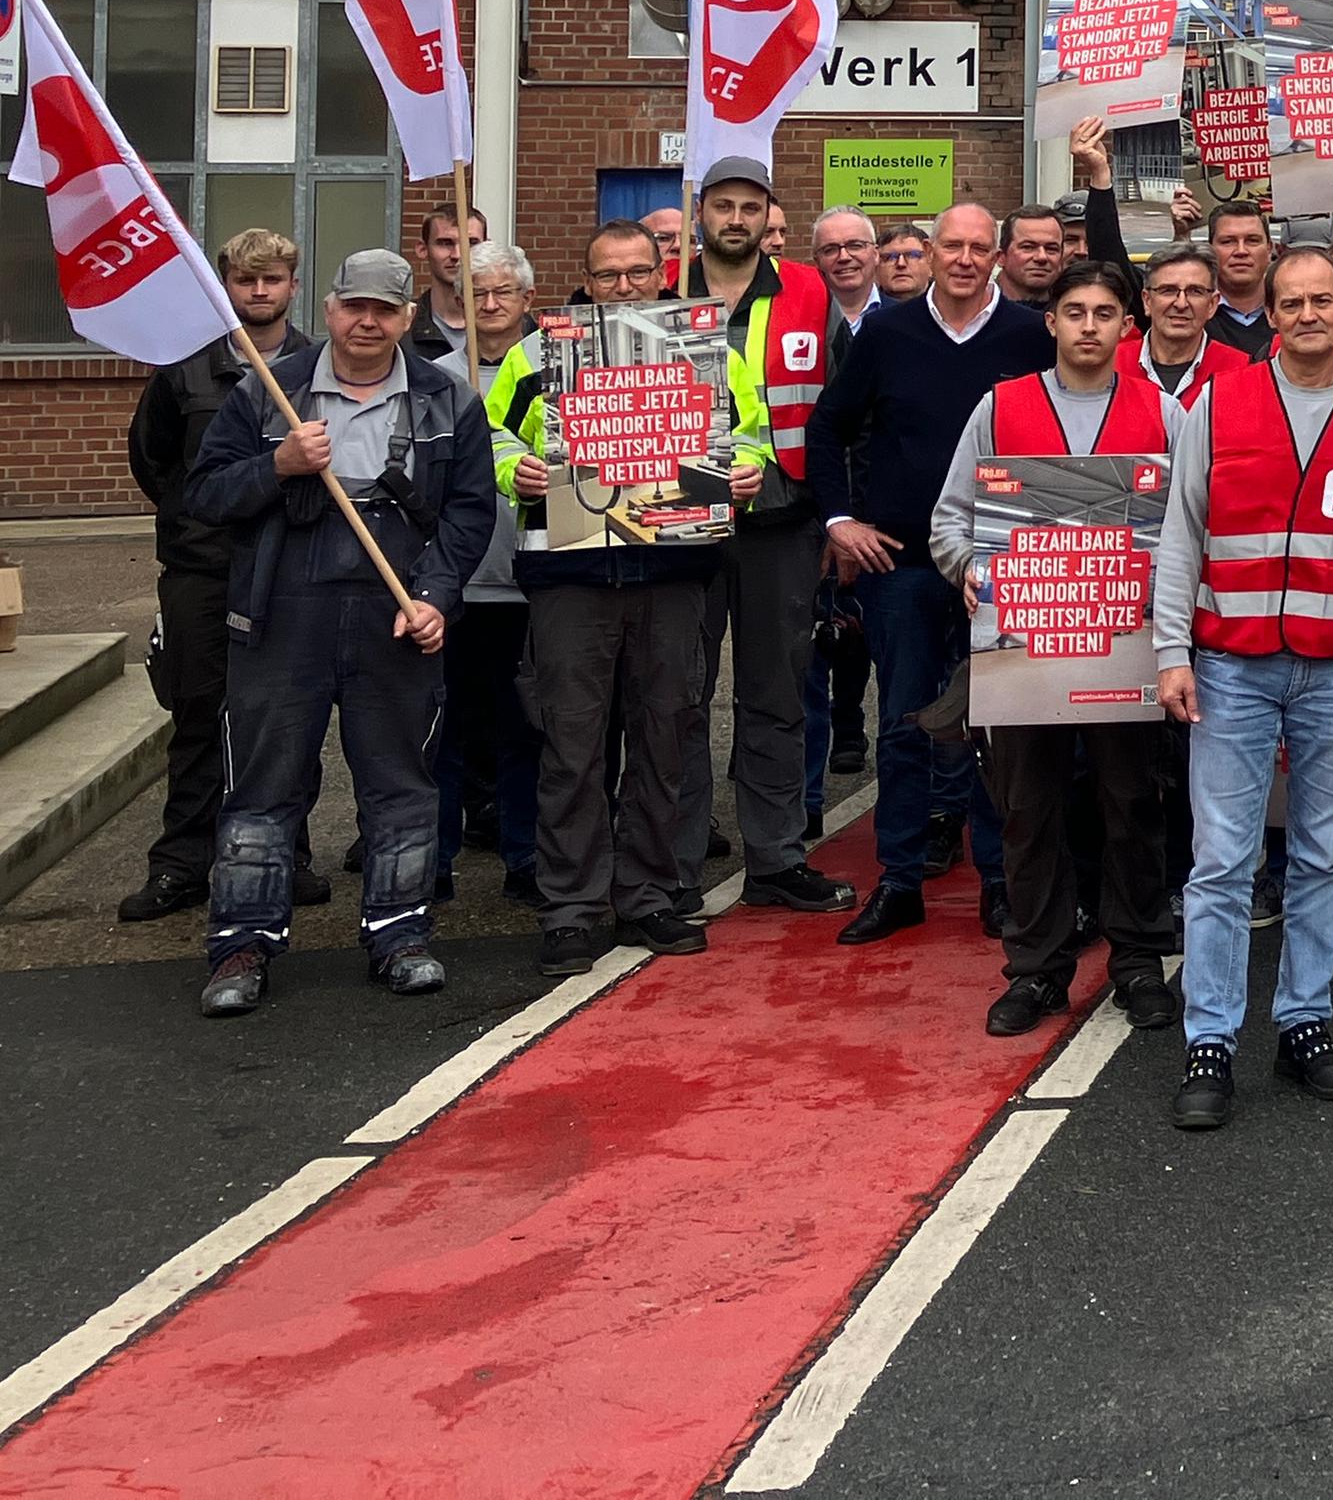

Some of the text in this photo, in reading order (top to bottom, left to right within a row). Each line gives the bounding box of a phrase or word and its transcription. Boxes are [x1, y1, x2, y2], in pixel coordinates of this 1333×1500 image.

[1062, 13, 1115, 31] ENERGIE
[1120, 6, 1158, 24] JETZT
[1062, 21, 1168, 49] STANDORTE UND
[1063, 39, 1162, 67] ARBEITSPLÄTZE
[957, 48, 975, 86] 1
[1084, 62, 1137, 81] RETTEN!
[1209, 91, 1268, 108] BEZAHLB
[1196, 111, 1249, 127] ENERGIE
[1201, 126, 1269, 143] STANDORT
[829, 155, 948, 168] Entladestelle 7
[1205, 145, 1270, 162] ARBEITSPL
[1229, 162, 1271, 178] RETTE
[858, 177, 918, 187] Tankwagen
[860, 189, 915, 198] Hilfsstoffe
[583, 366, 687, 391] BEZAHLBARE
[565, 393, 634, 416] ENERGIE
[639, 389, 689, 410] JETZT
[569, 411, 704, 439] STANDORTE UND
[574, 432, 700, 462] ARBEITSPLÄTZE
[604, 461, 671, 482] RETTEN!
[1017, 531, 1126, 552] BEZAHLBARE
[997, 557, 1068, 578] ENERGIE
[1075, 556, 1127, 577] JETZT
[1000, 580, 1141, 604] STANDORTE UND
[1003, 604, 1136, 629] ARBEITSPLÄTZE
[1034, 632, 1104, 654] RETTEN!
